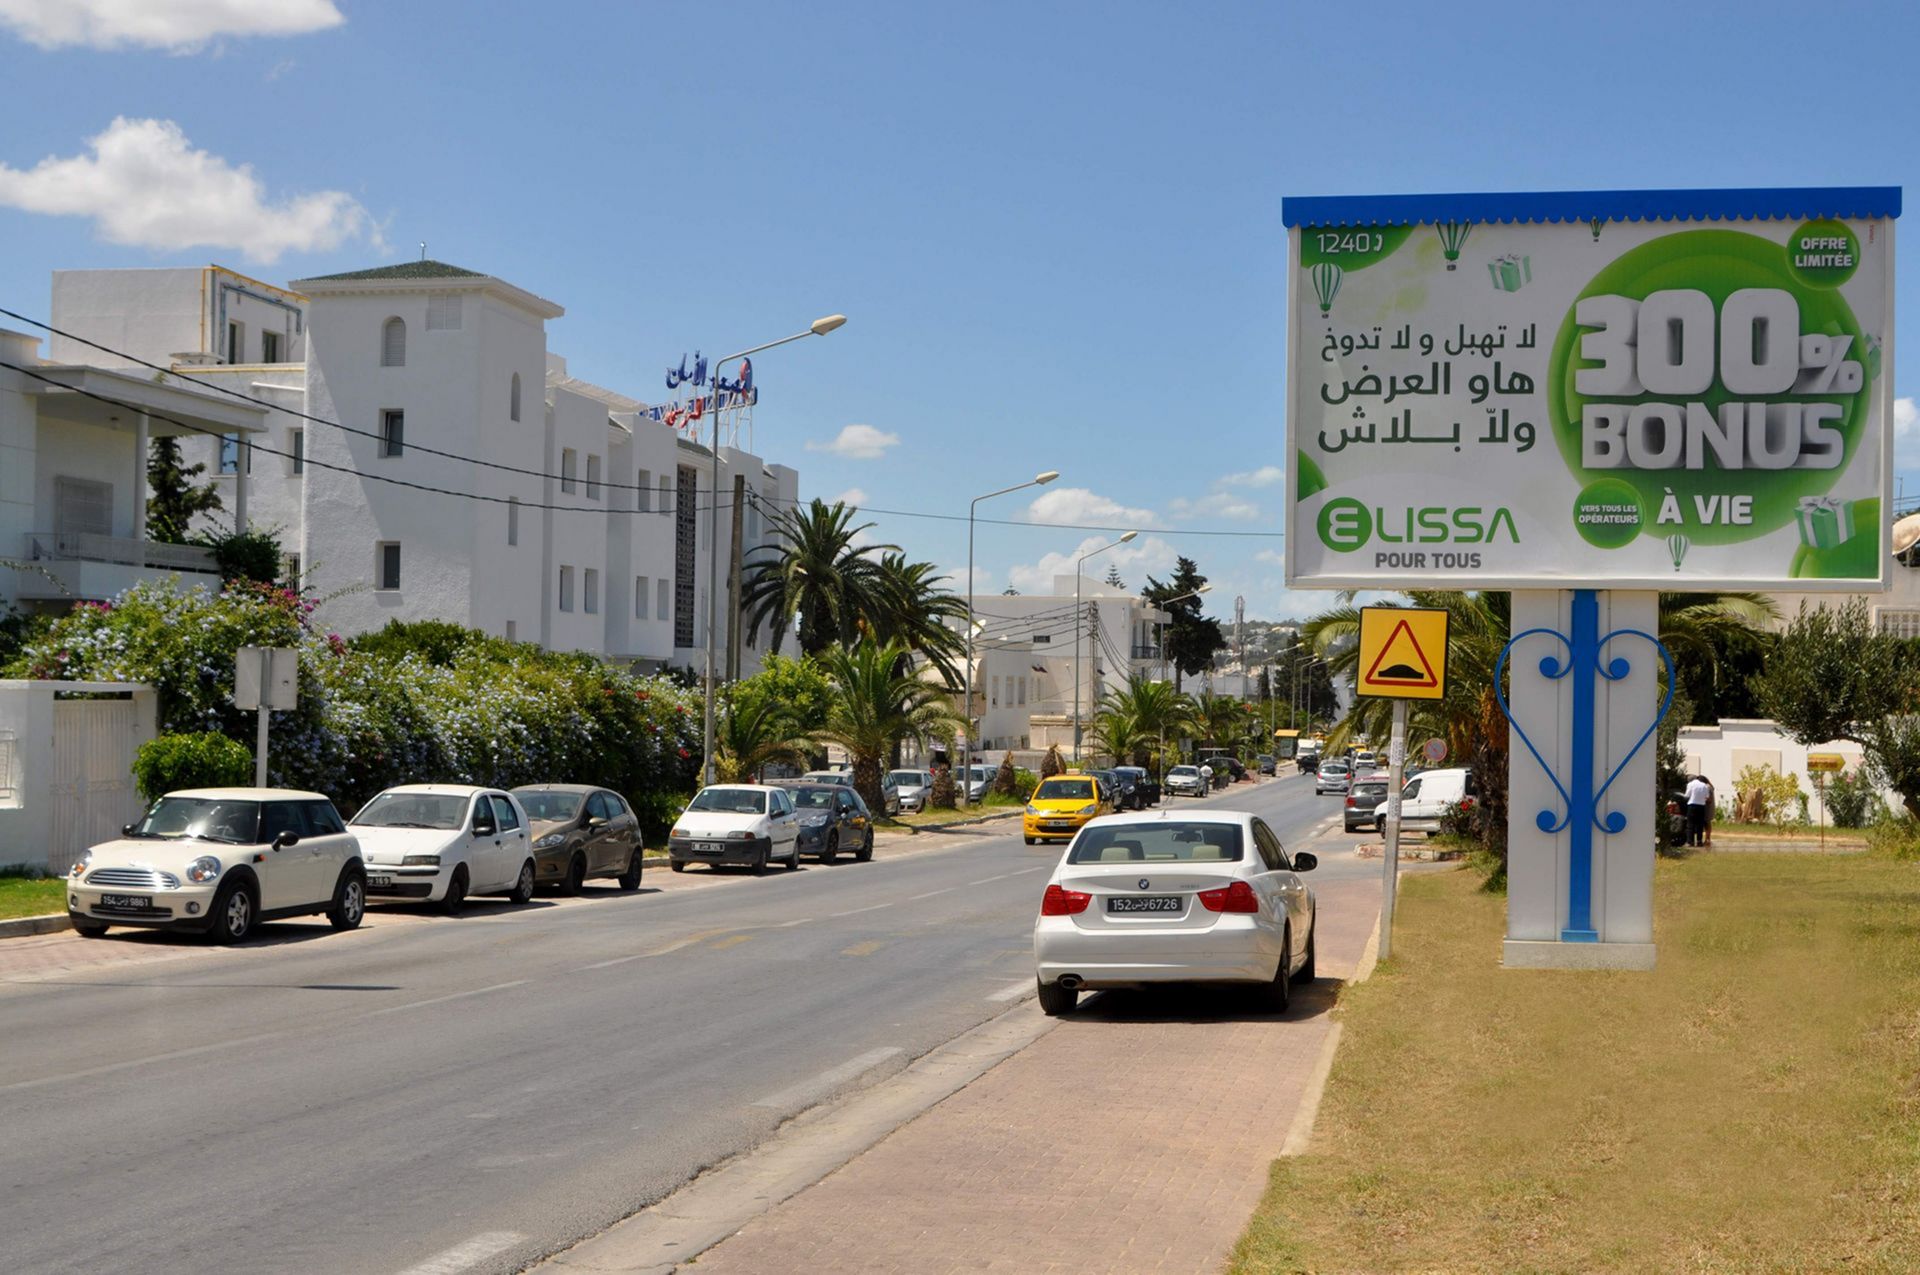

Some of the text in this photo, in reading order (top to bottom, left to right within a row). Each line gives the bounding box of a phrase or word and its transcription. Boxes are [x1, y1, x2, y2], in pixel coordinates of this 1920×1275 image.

[1316, 233, 1370, 253] 1240
[1801, 237, 1847, 250] OFFRE
[1795, 251, 1853, 267] LIMITÉE
[1321, 327, 1382, 362] تدوخ
[1444, 323, 1507, 358] تهبل
[1516, 323, 1536, 348] لا
[1575, 288, 1864, 396] 300%
[1320, 361, 1534, 405] هاو العرض
[1582, 402, 1844, 470] BONUS
[1578, 513, 1639, 524] OPÉRATEURS
[1580, 504, 1637, 512] VERS TOUS LES
[1656, 487, 1753, 525] À VIE
[1317, 497, 1521, 552] ELISSA
[1375, 552, 1482, 568] POUR TOUS
[1113, 899, 1132, 911] 152
[1149, 898, 1178, 910] 6726
